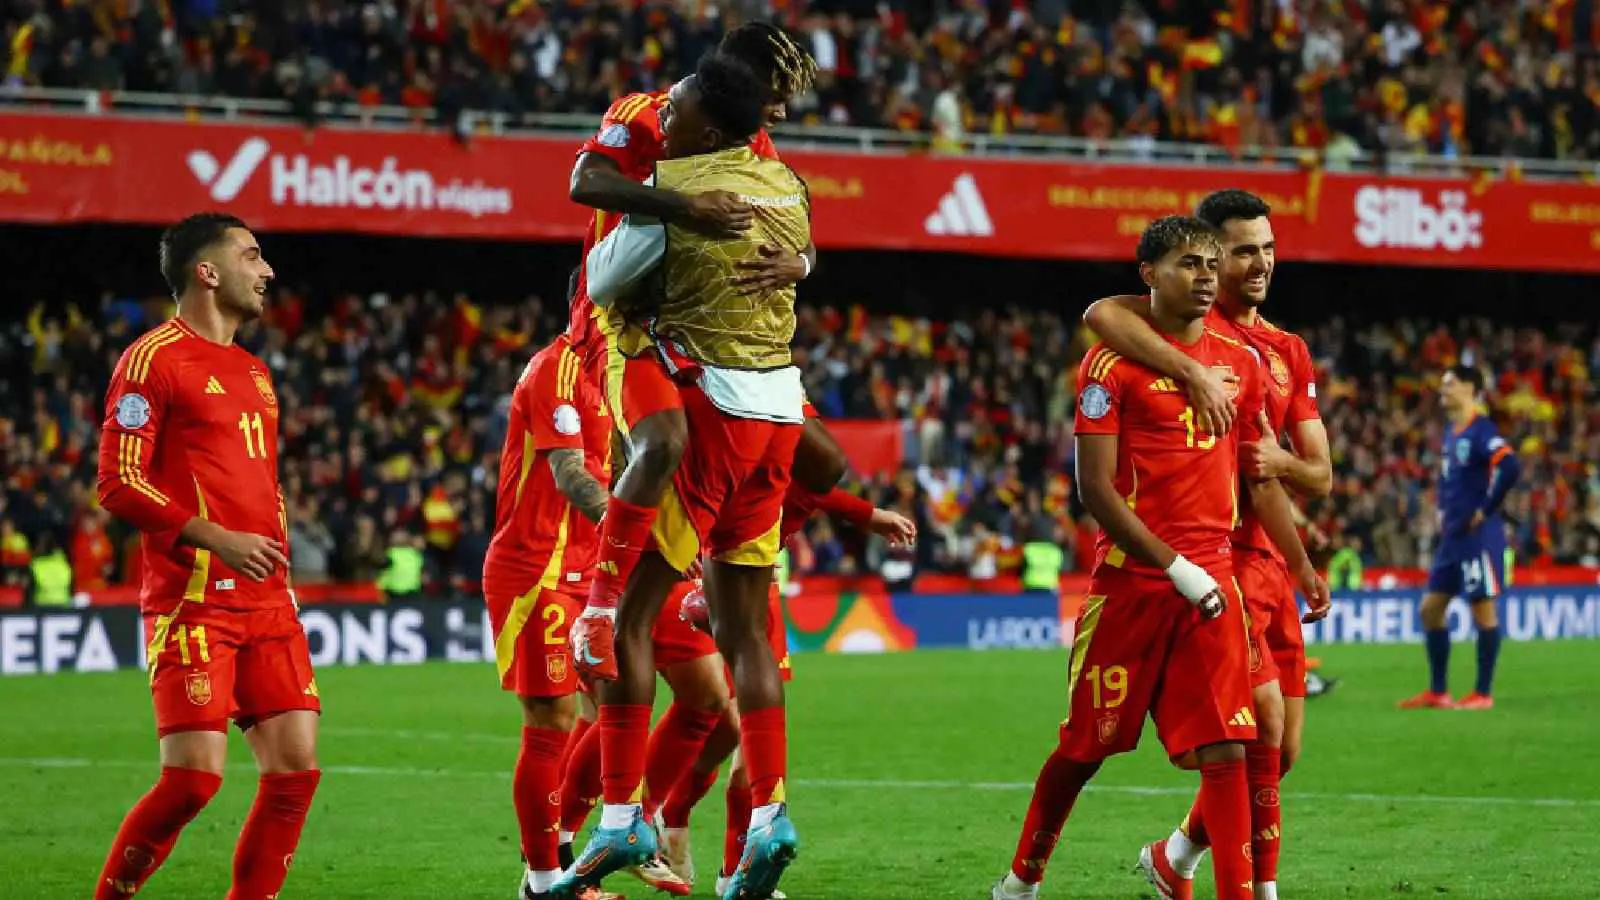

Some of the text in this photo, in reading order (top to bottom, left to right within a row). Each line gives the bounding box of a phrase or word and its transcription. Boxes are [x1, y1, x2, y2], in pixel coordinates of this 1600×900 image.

[270, 155, 433, 209] Halcón
[238, 413, 267, 458] 11
[542, 604, 567, 645] 2
[1506, 593, 1600, 639] UVM
[0, 613, 118, 677] EFA
[172, 623, 210, 666] 11
[1086, 665, 1128, 709] 19
